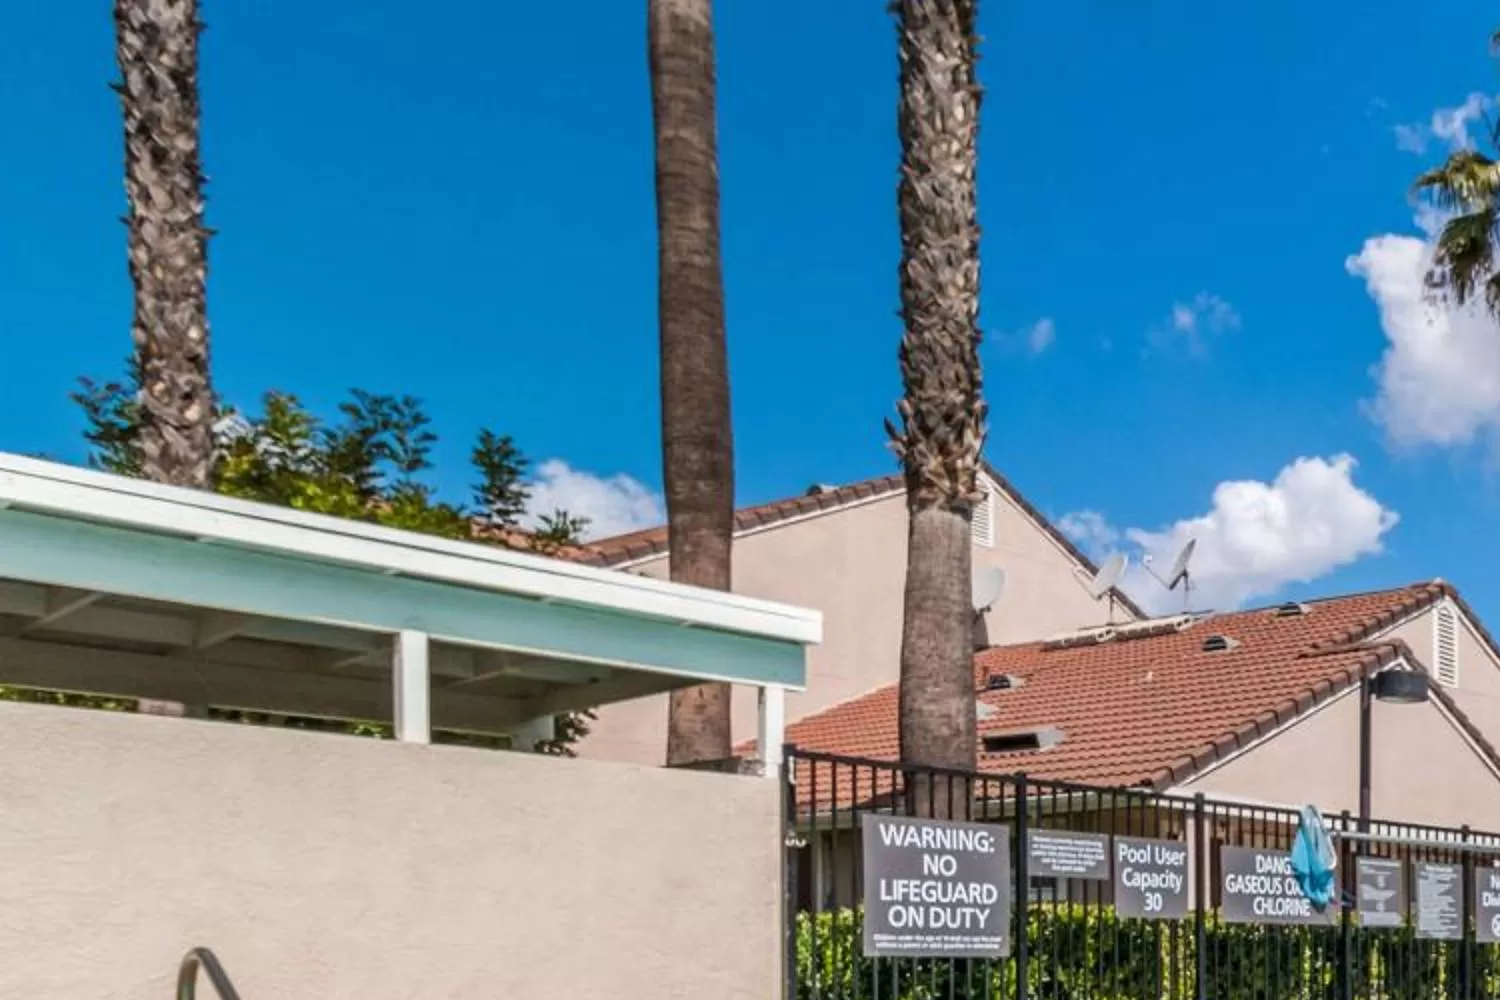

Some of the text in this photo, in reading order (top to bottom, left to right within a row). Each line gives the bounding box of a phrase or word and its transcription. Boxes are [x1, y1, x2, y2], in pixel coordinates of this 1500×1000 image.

[879, 823, 996, 853] WARNING:
[923, 853, 957, 876] NO
[1118, 844, 1151, 864] Pool
[1155, 846, 1186, 866] User
[1255, 855, 1291, 875] DANG
[880, 878, 998, 904] LIFEGUARD
[1122, 867, 1183, 895] Capacity
[1225, 874, 1283, 895] GASEOUS
[1144, 892, 1163, 912] 30
[1253, 896, 1311, 917] CHLORINE
[888, 905, 990, 928] ON DUTY
